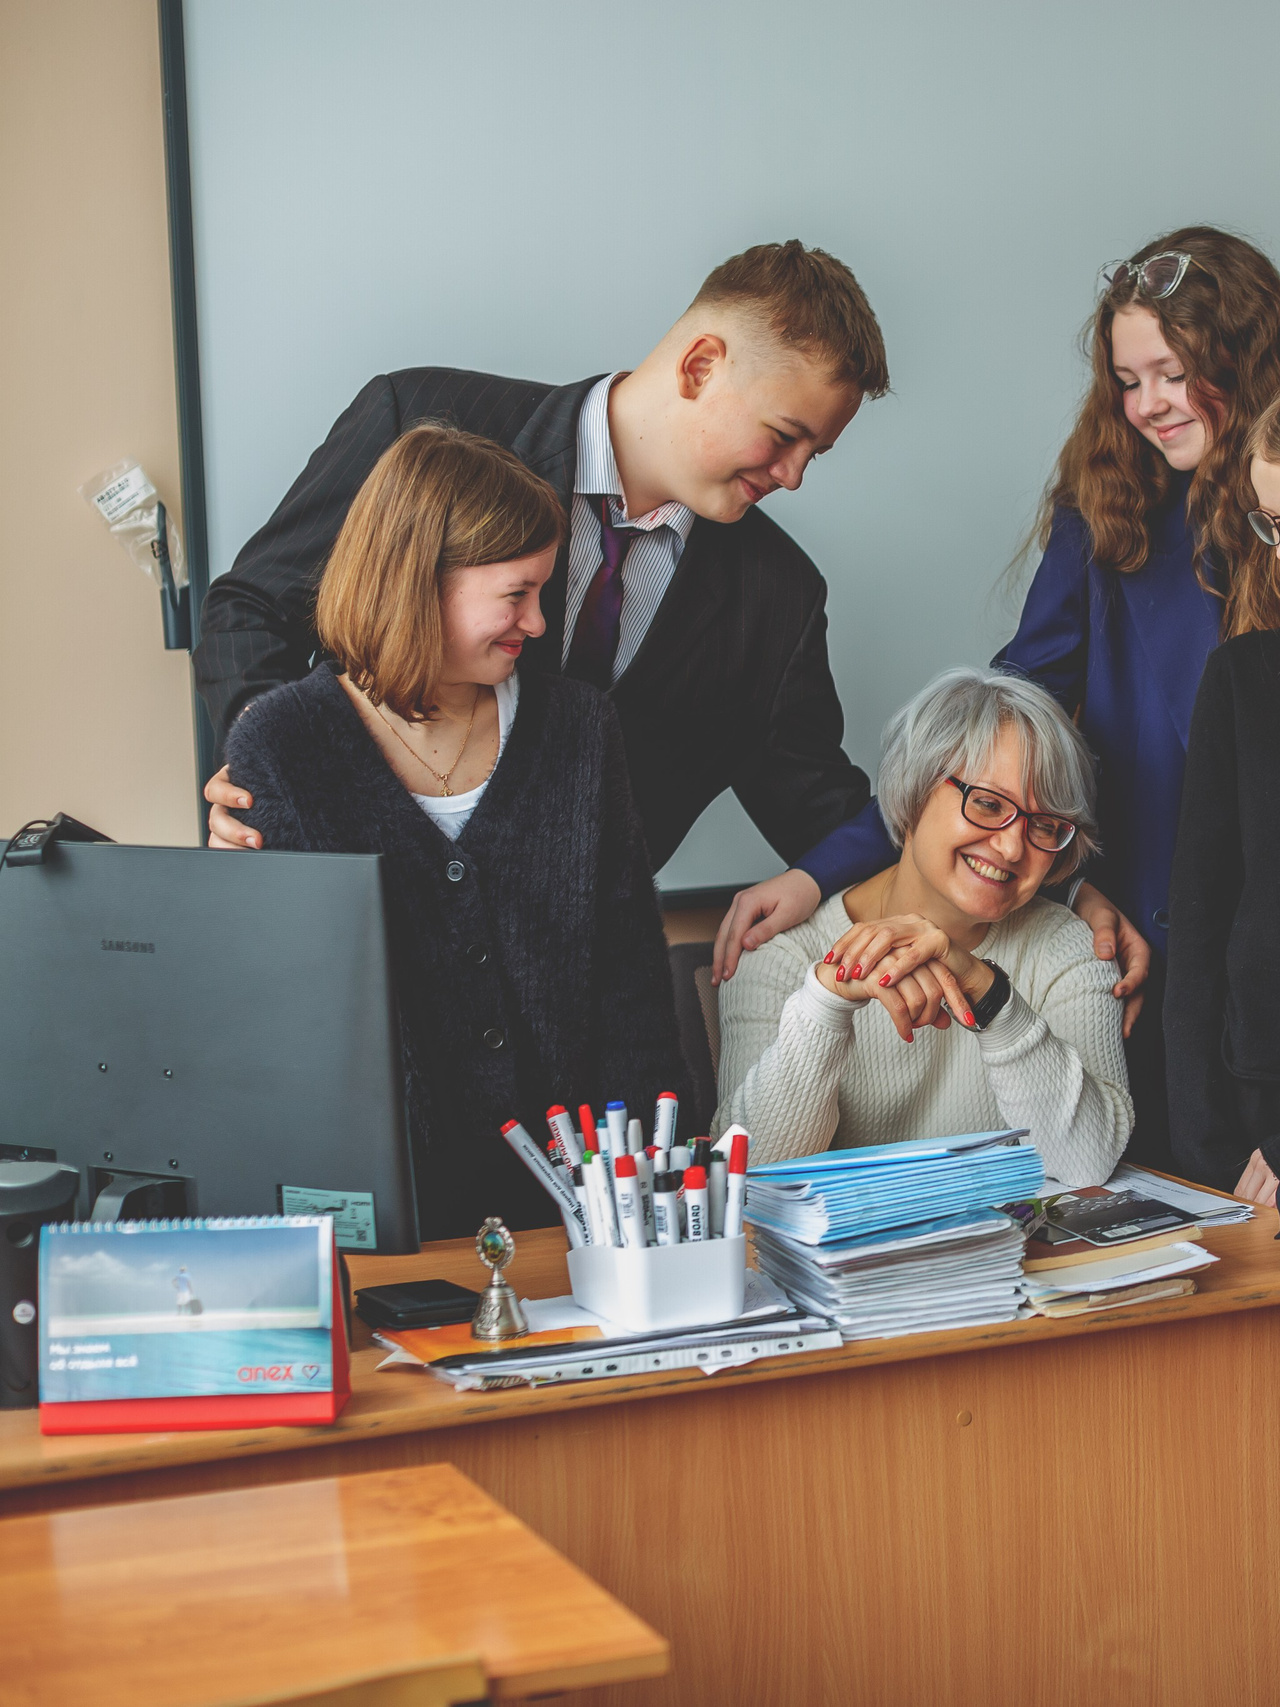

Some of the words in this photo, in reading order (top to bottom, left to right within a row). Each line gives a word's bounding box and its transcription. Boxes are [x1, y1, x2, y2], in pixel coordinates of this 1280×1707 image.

[101, 940, 155, 953] SAMSUNG
[550, 1119, 568, 1157] MARKER
[691, 1204, 701, 1236] BOARD
[237, 1363, 294, 1383] anex
